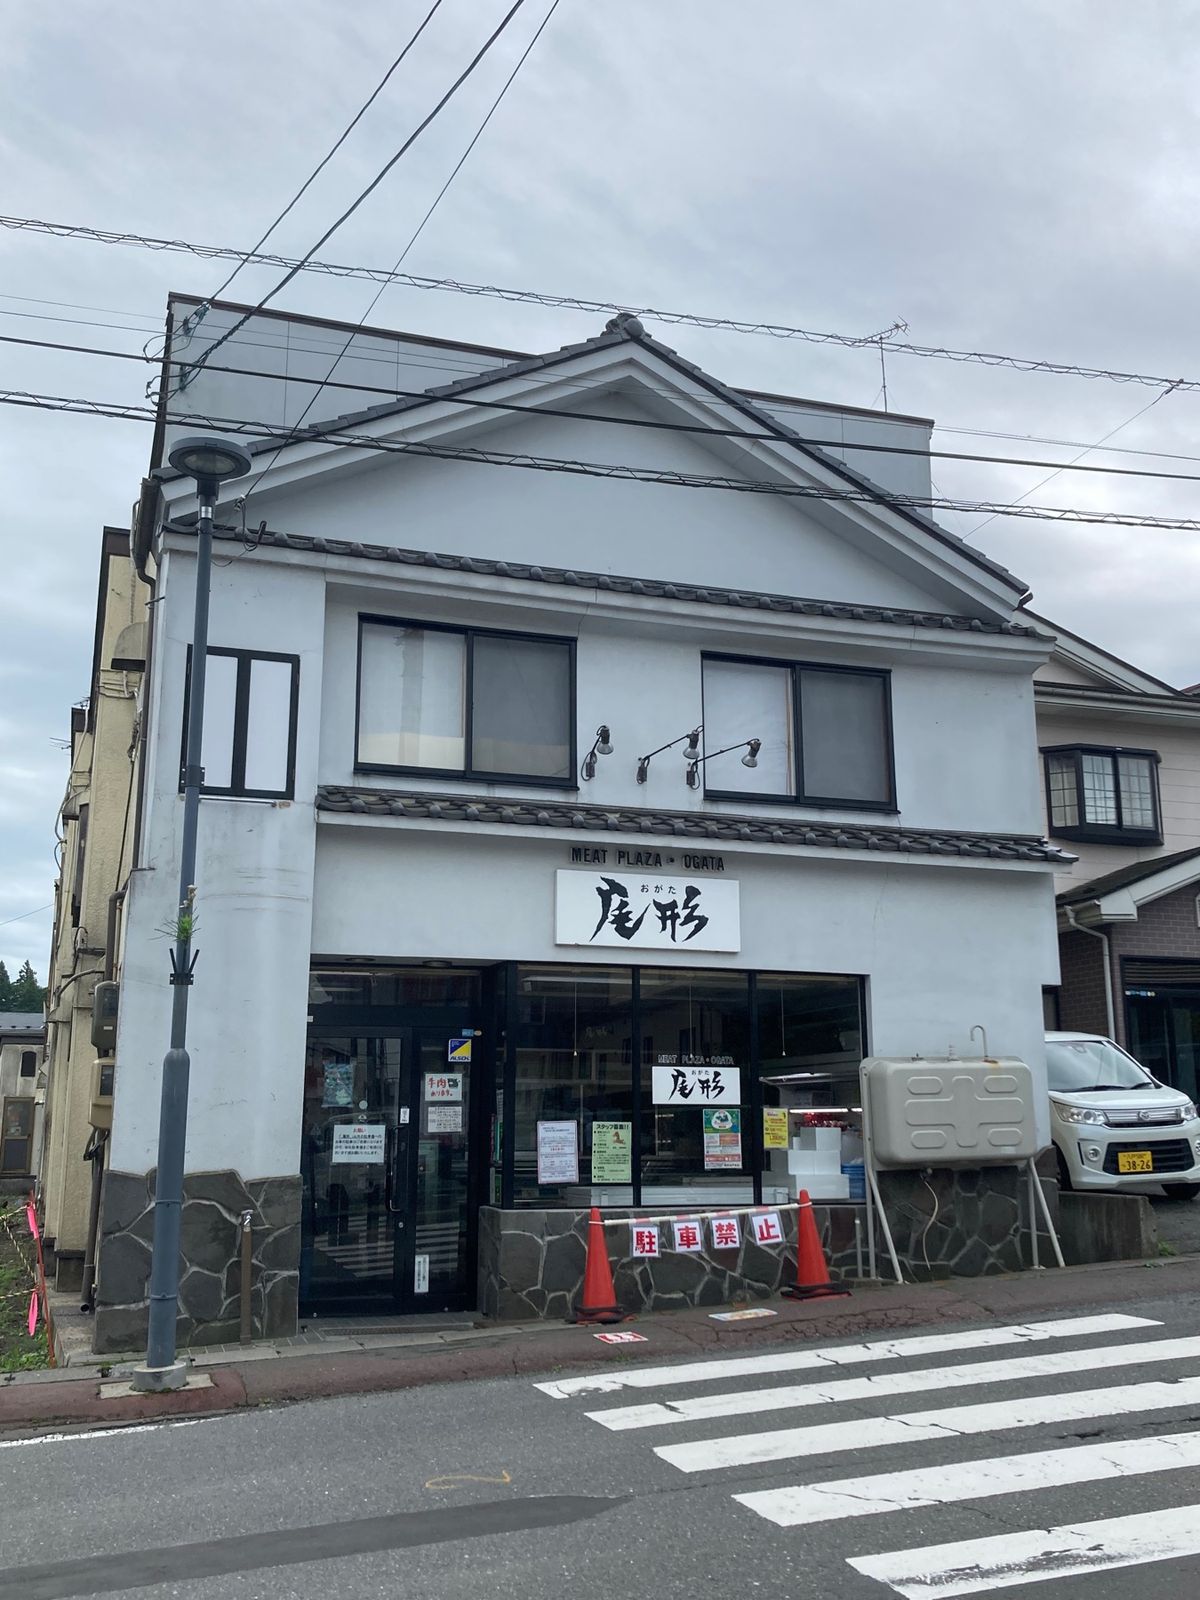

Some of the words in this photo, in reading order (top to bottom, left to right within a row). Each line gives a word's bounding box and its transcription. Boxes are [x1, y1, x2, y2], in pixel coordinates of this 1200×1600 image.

[571, 846, 608, 864] MEAT
[617, 849, 663, 867] PLAZA
[682, 853, 725, 872] OGATA
[640, 884, 677, 895] おがた
[589, 875, 710, 943] 尾形
[681, 1054, 705, 1064] PLAZA
[668, 1068, 725, 1100] 尾形
[1127, 1160, 1151, 1170] 38-26
[634, 1219, 780, 1254] 駐車禁止
